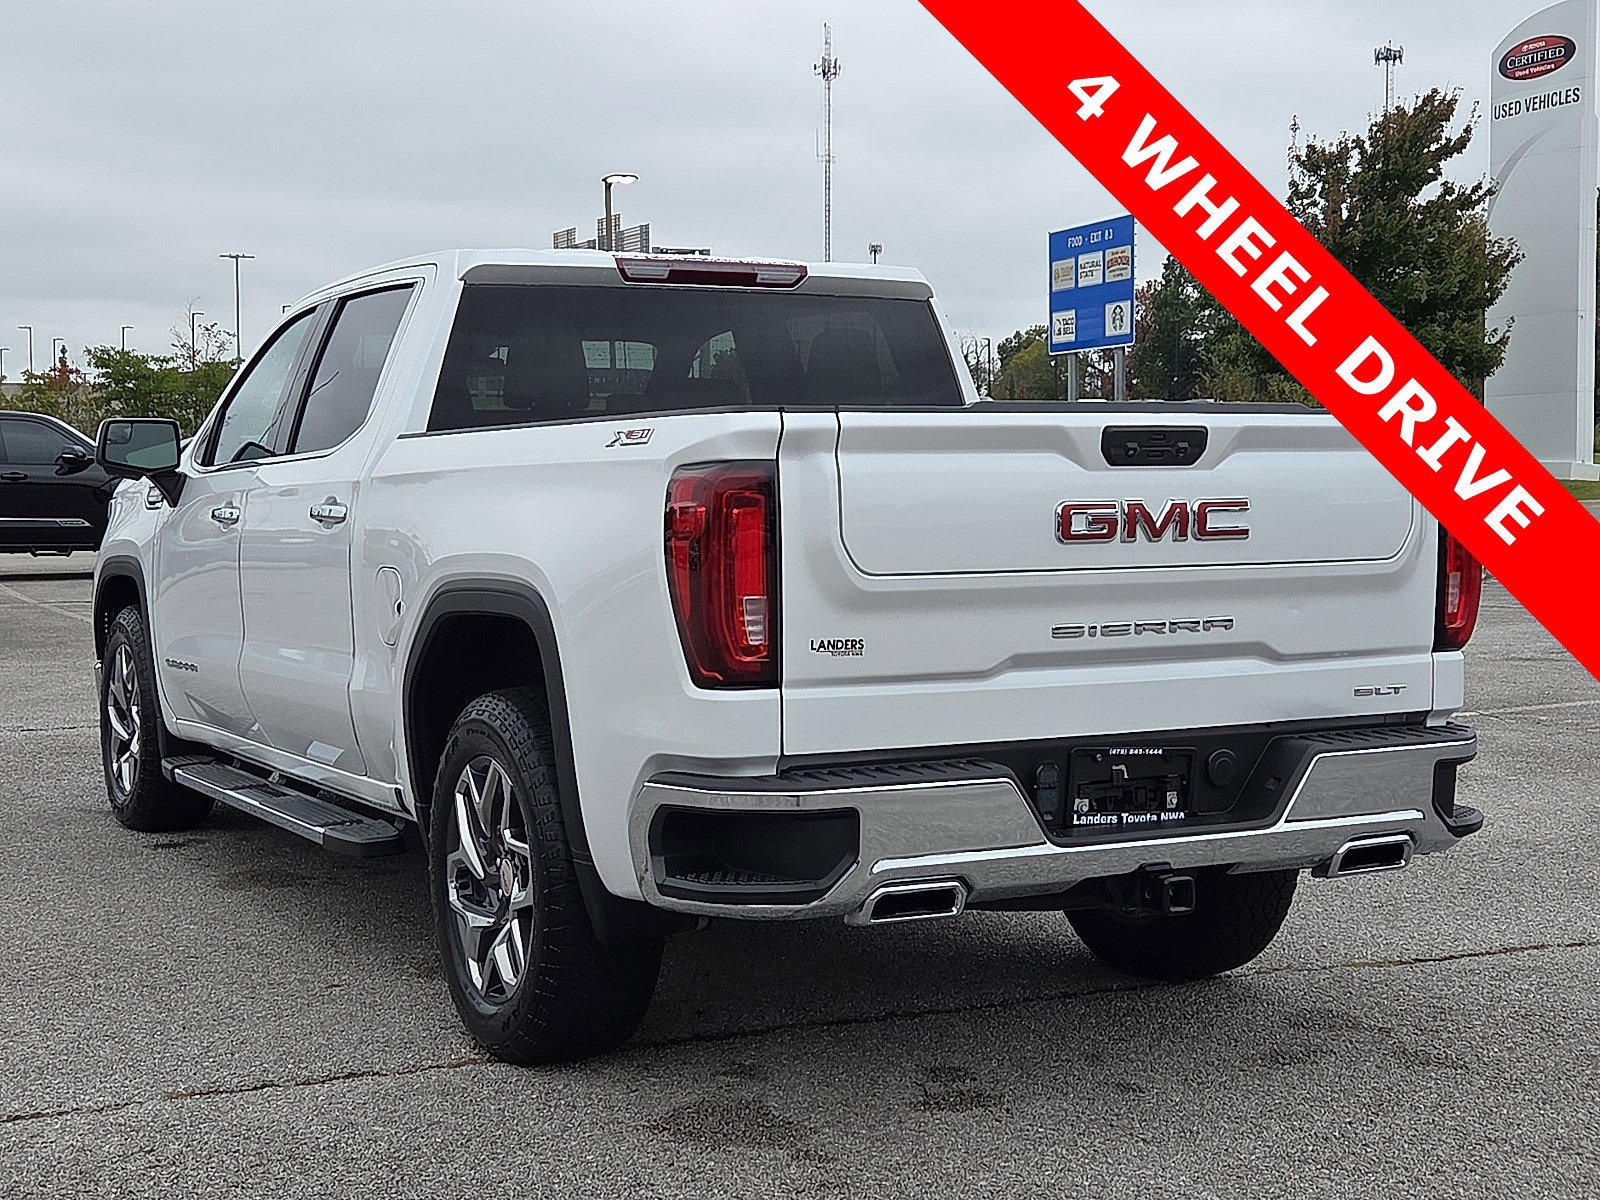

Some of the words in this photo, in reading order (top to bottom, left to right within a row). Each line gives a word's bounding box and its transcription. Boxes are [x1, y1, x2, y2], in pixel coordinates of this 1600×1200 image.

[1506, 47, 1565, 69] CERTIFIED
[1515, 68, 1530, 78] Used
[1494, 100, 1522, 120] USED
[1524, 87, 1580, 113] VEHICLES
[1067, 235, 1083, 248] FOOD
[1090, 231, 1102, 243] EXIT
[1079, 260, 1101, 270] NATURAL
[1079, 270, 1095, 279] STATE
[1062, 317, 1074, 326] TACO
[1062, 326, 1075, 336] BELL
[1054, 497, 1251, 544] GMC
[1051, 616, 1235, 640] SIERRA
[810, 638, 865, 653] LANDERS
[1353, 683, 1407, 698] SLT
[1072, 812, 1118, 825] Landers
[1120, 811, 1158, 824] Toyota
[1160, 810, 1185, 821] NWA
